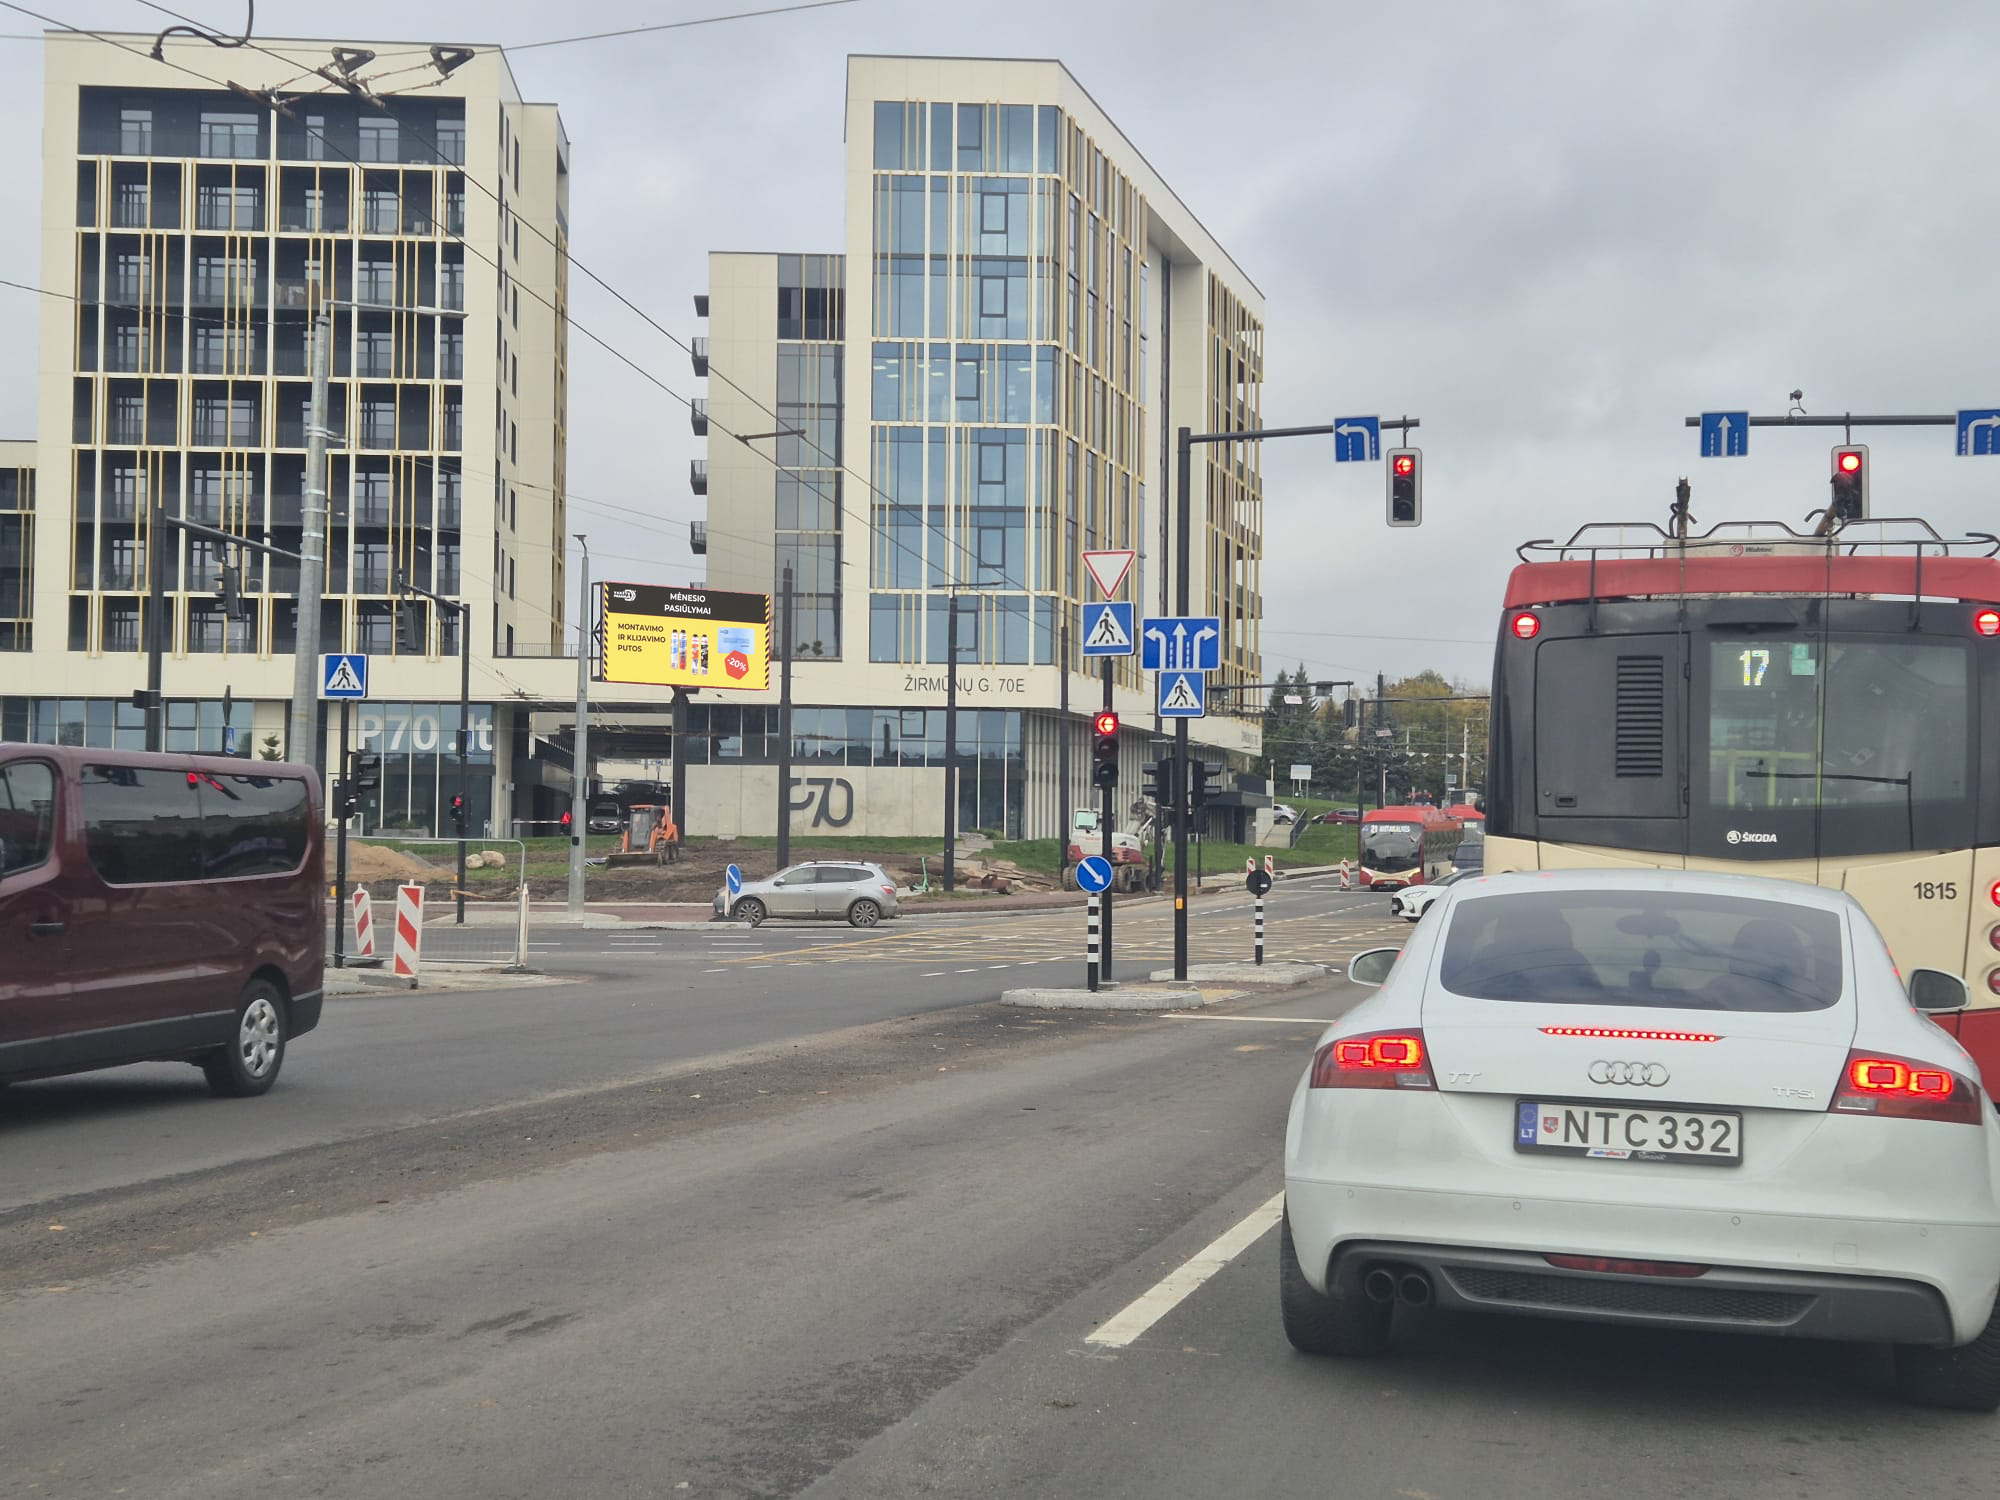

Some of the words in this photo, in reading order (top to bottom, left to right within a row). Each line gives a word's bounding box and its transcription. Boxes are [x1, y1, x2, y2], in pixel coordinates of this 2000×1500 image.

[670, 592, 706, 603] MĖNESIO
[664, 604, 711, 615] PASIŪLYMAI
[618, 623, 664, 633] MONTAVIMO
[618, 633, 626, 641] IR
[627, 634, 666, 643] KLIJAVIMO
[618, 644, 643, 653] PUTOS
[727, 657, 747, 672] -20%
[1738, 649, 1770, 686] 17
[978, 677, 993, 693] G.
[998, 678, 1025, 693] 70E
[1742, 831, 1777, 843] ŠKODA
[1913, 881, 1958, 900] 1815
[1448, 1071, 1482, 1085] TT
[1520, 1128, 1534, 1139] LT
